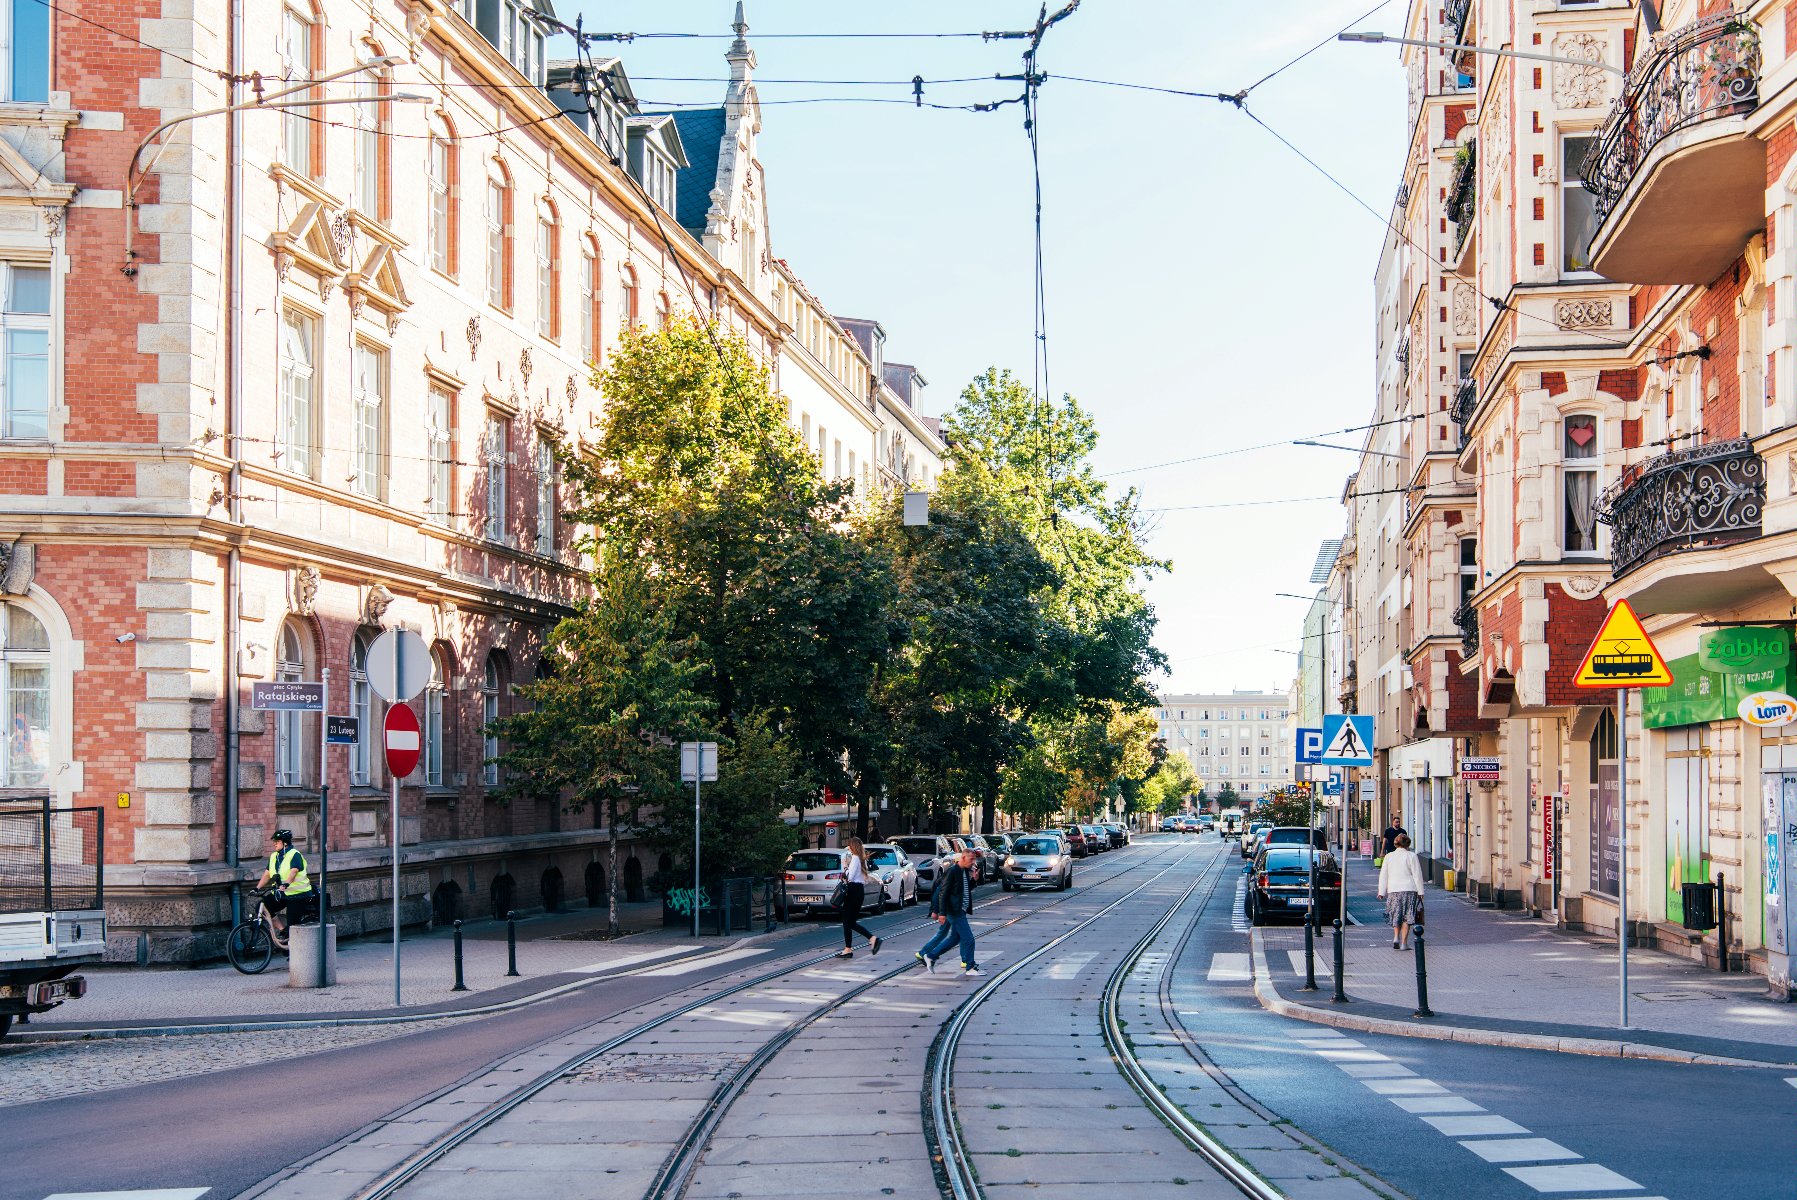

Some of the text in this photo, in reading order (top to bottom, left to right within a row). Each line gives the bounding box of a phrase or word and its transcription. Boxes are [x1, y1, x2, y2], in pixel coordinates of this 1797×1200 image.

[1707, 638, 1784, 659] żabka
[258, 691, 318, 703] Ratajskiego
[1757, 705, 1787, 719] LOTTO
[330, 725, 355, 736] 23 Lutego
